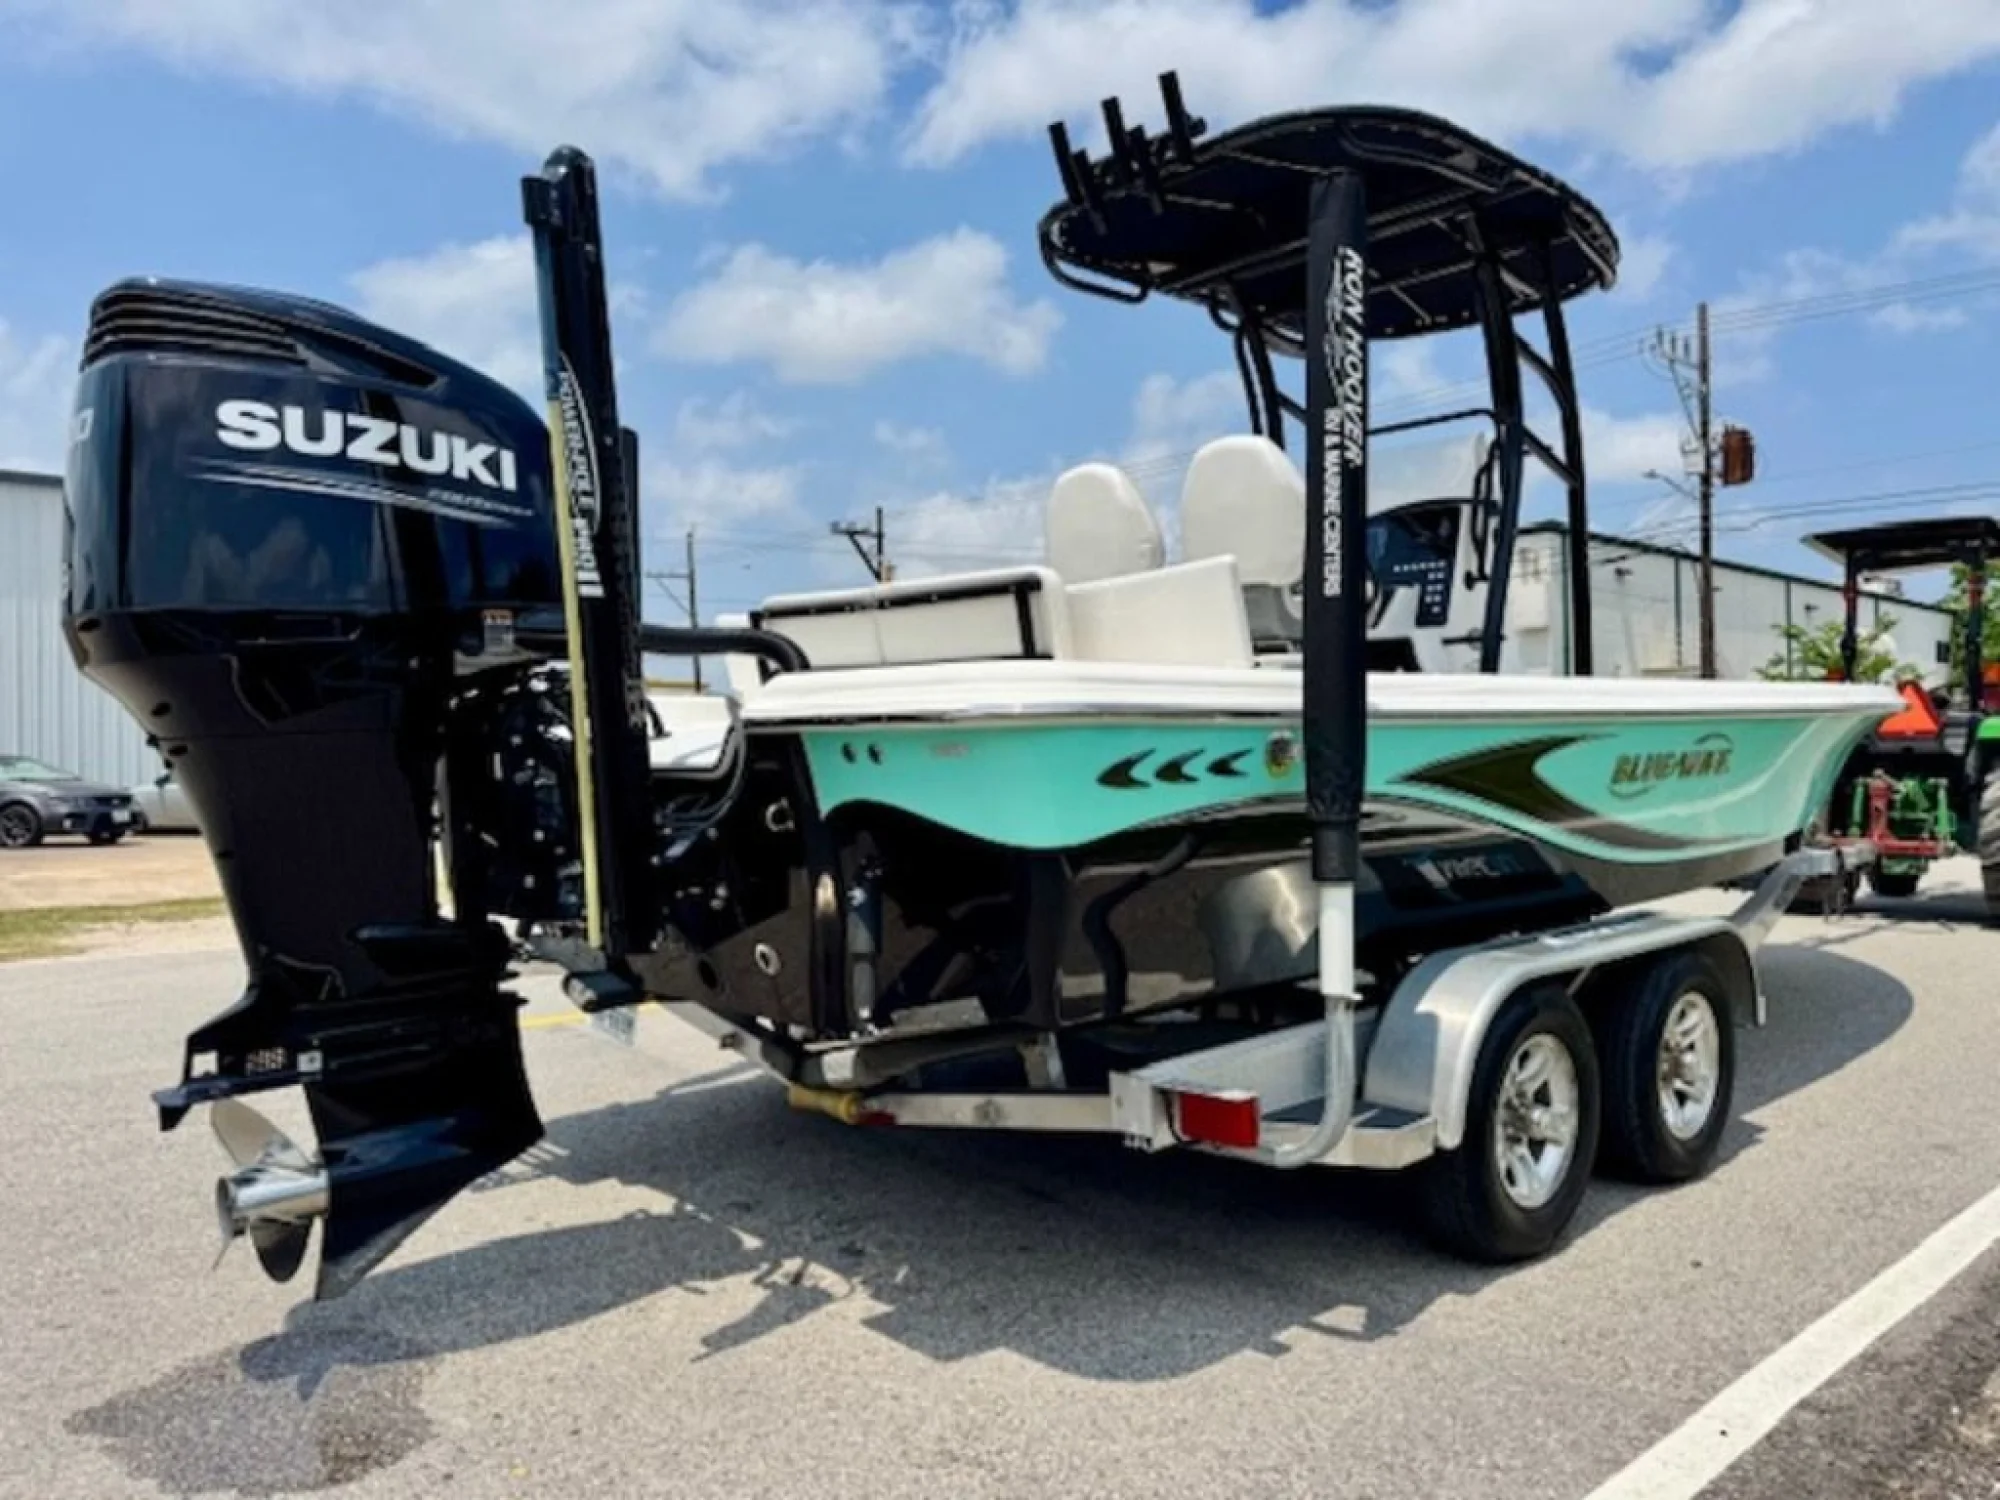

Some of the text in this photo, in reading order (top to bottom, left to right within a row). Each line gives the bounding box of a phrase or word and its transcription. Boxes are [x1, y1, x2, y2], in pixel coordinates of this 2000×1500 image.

[1337, 245, 1364, 467] RON HOOVER
[215, 398, 517, 492] SUZUKI
[1323, 407, 1342, 432] RV
[1323, 449, 1342, 516] MARINE
[1323, 516, 1342, 597] CENTERS
